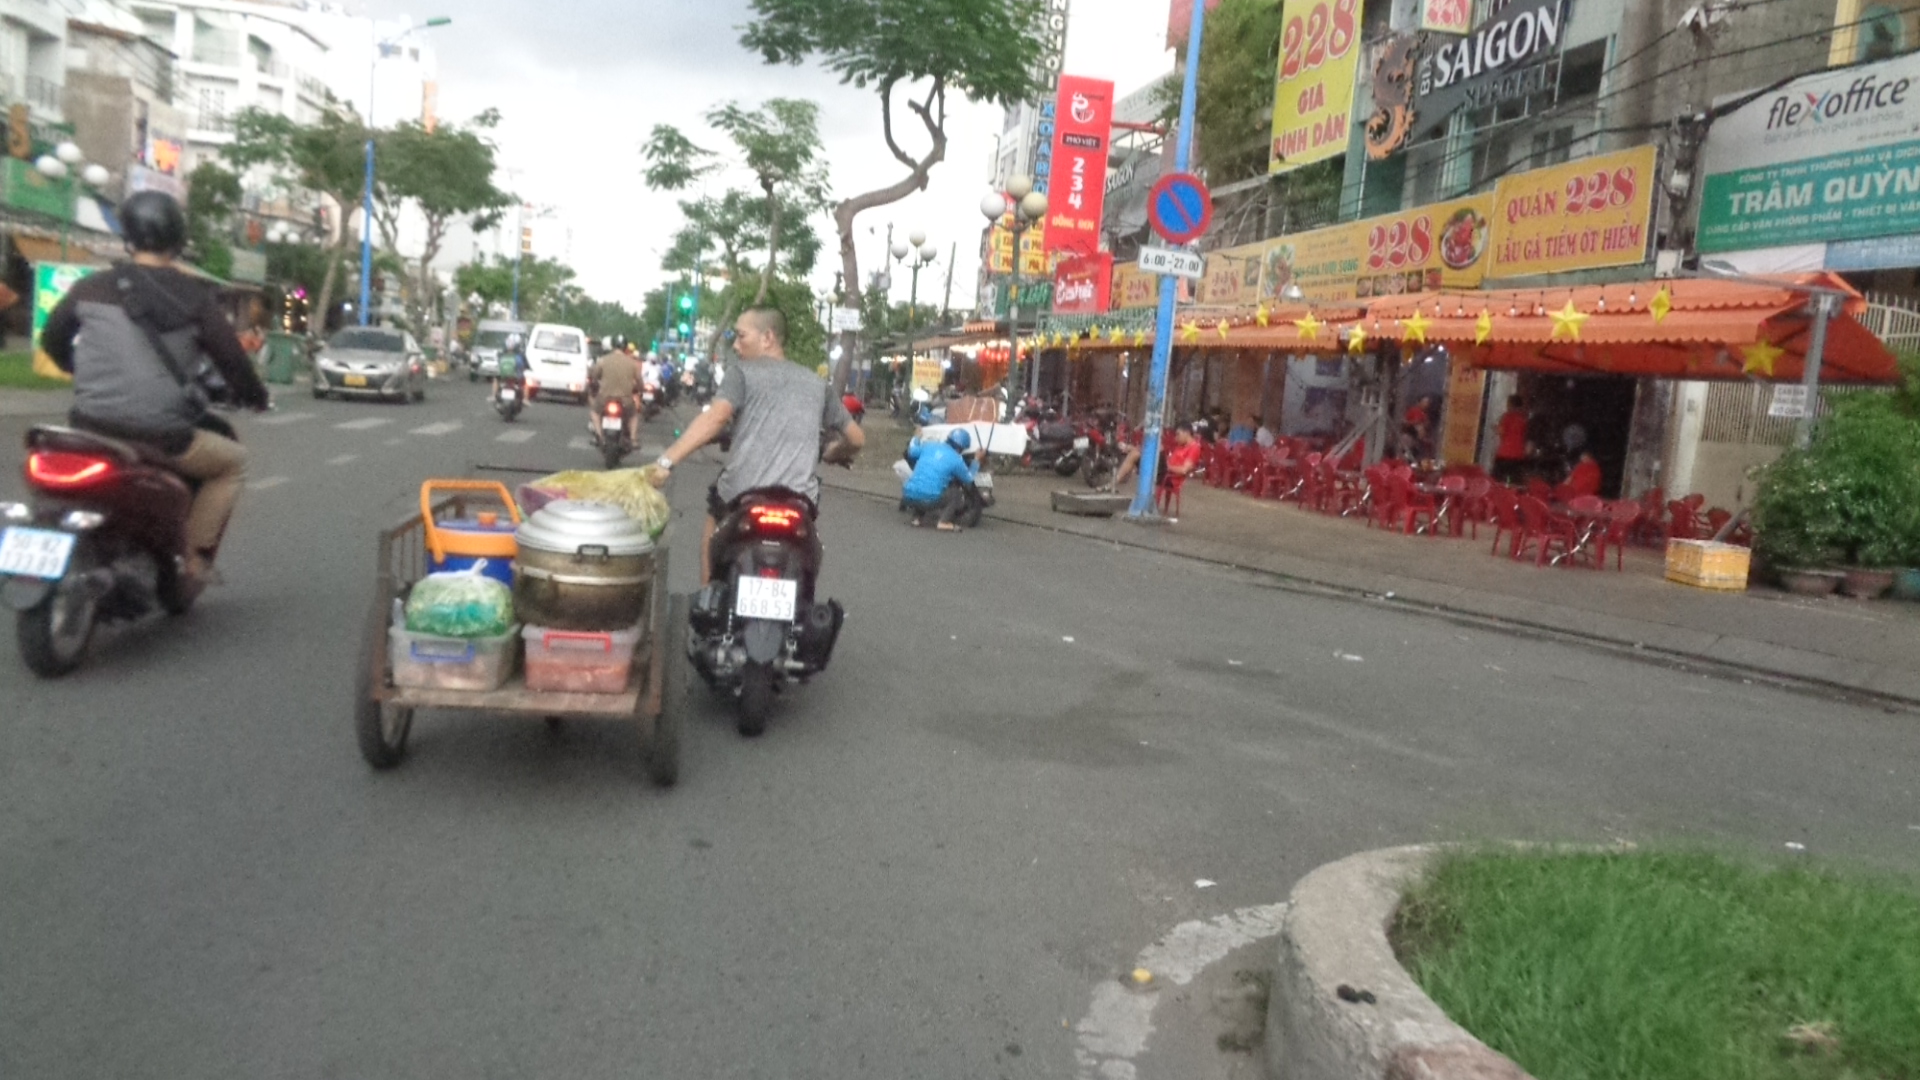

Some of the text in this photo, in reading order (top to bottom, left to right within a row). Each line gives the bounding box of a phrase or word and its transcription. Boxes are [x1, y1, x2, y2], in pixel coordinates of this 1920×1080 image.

[1279, 0, 1356, 82] 228
[1434, 3, 1561, 88] SAIGON
[1420, 53, 1433, 96] BIA
[1564, 165, 1637, 216] 228
[1729, 181, 1814, 216] TRÂM
[1367, 214, 1433, 271] 228
